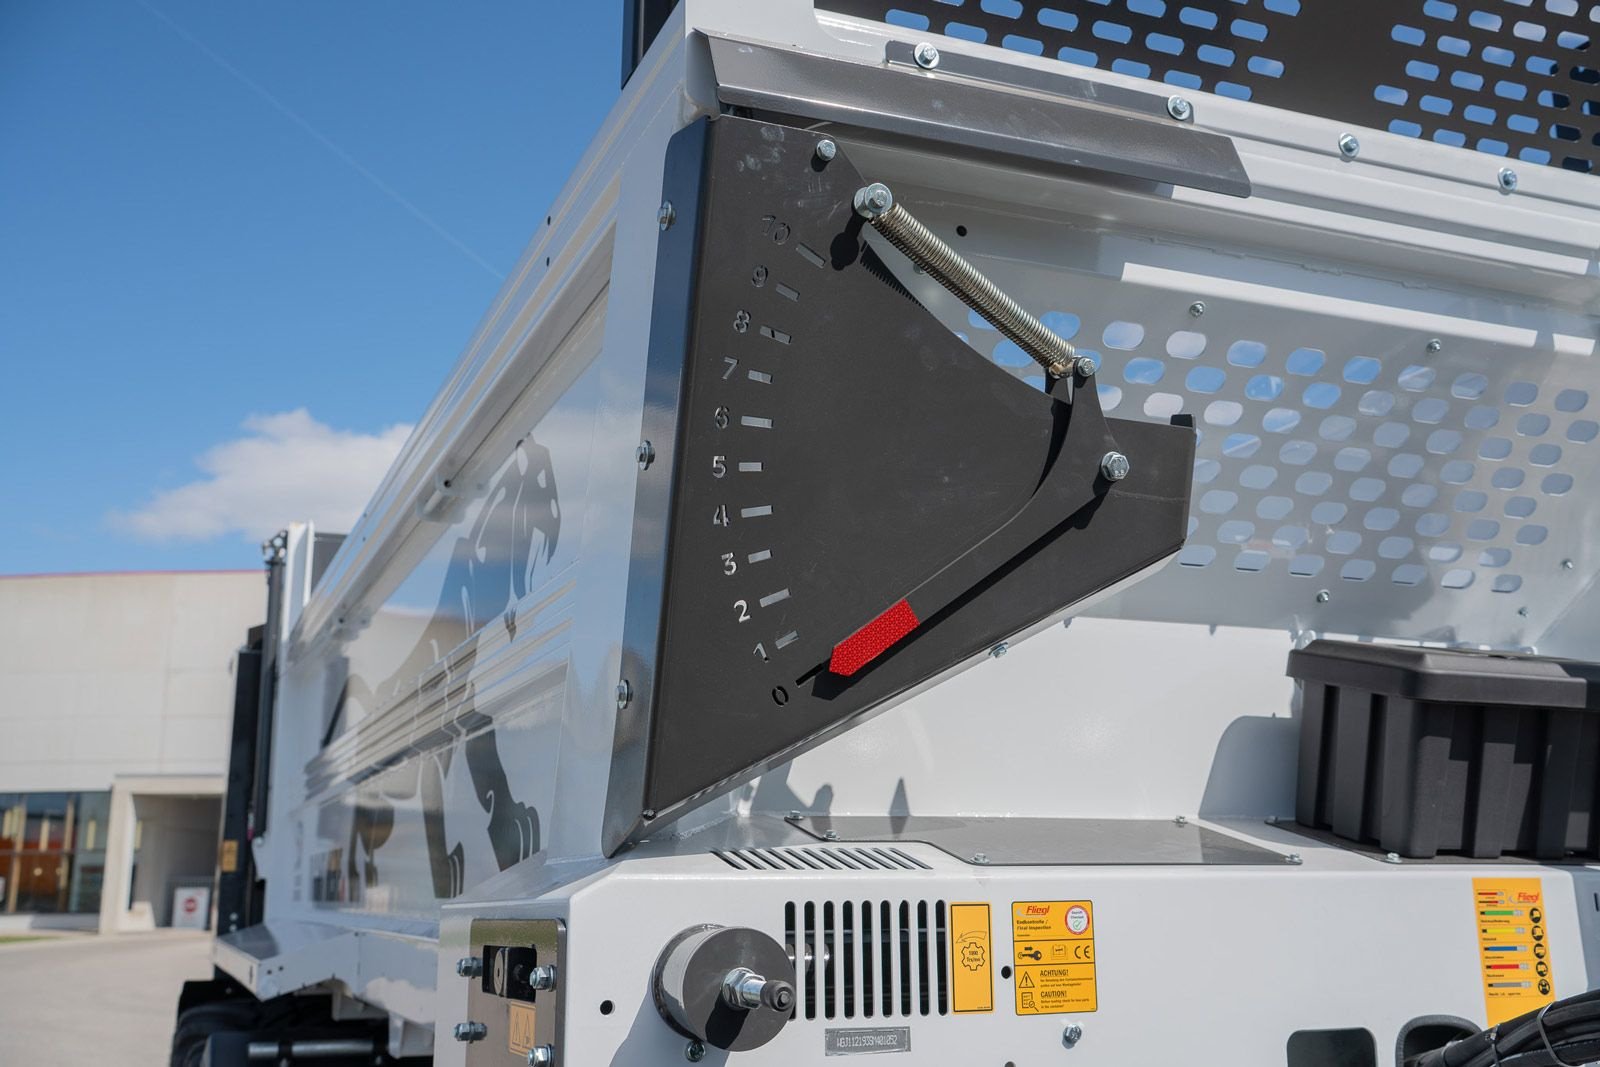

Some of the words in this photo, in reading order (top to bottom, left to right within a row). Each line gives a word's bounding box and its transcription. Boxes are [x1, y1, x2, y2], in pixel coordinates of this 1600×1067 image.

[761, 215, 791, 245] 10
[751, 265, 769, 287] 9
[733, 310, 751, 334] 8
[722, 357, 739, 380] 7
[713, 406, 730, 430] 6
[712, 455, 727, 479] 5
[712, 504, 730, 527] 4
[721, 552, 738, 576] 3
[733, 600, 751, 623] 2
[753, 642, 770, 663] 1
[772, 686, 790, 707] 0
[1518, 893, 1539, 902] Fliegl
[1026, 905, 1050, 916] Fliegl
[1040, 969, 1069, 977] ACHTUNG!
[1040, 990, 1067, 998] CAUTION!
